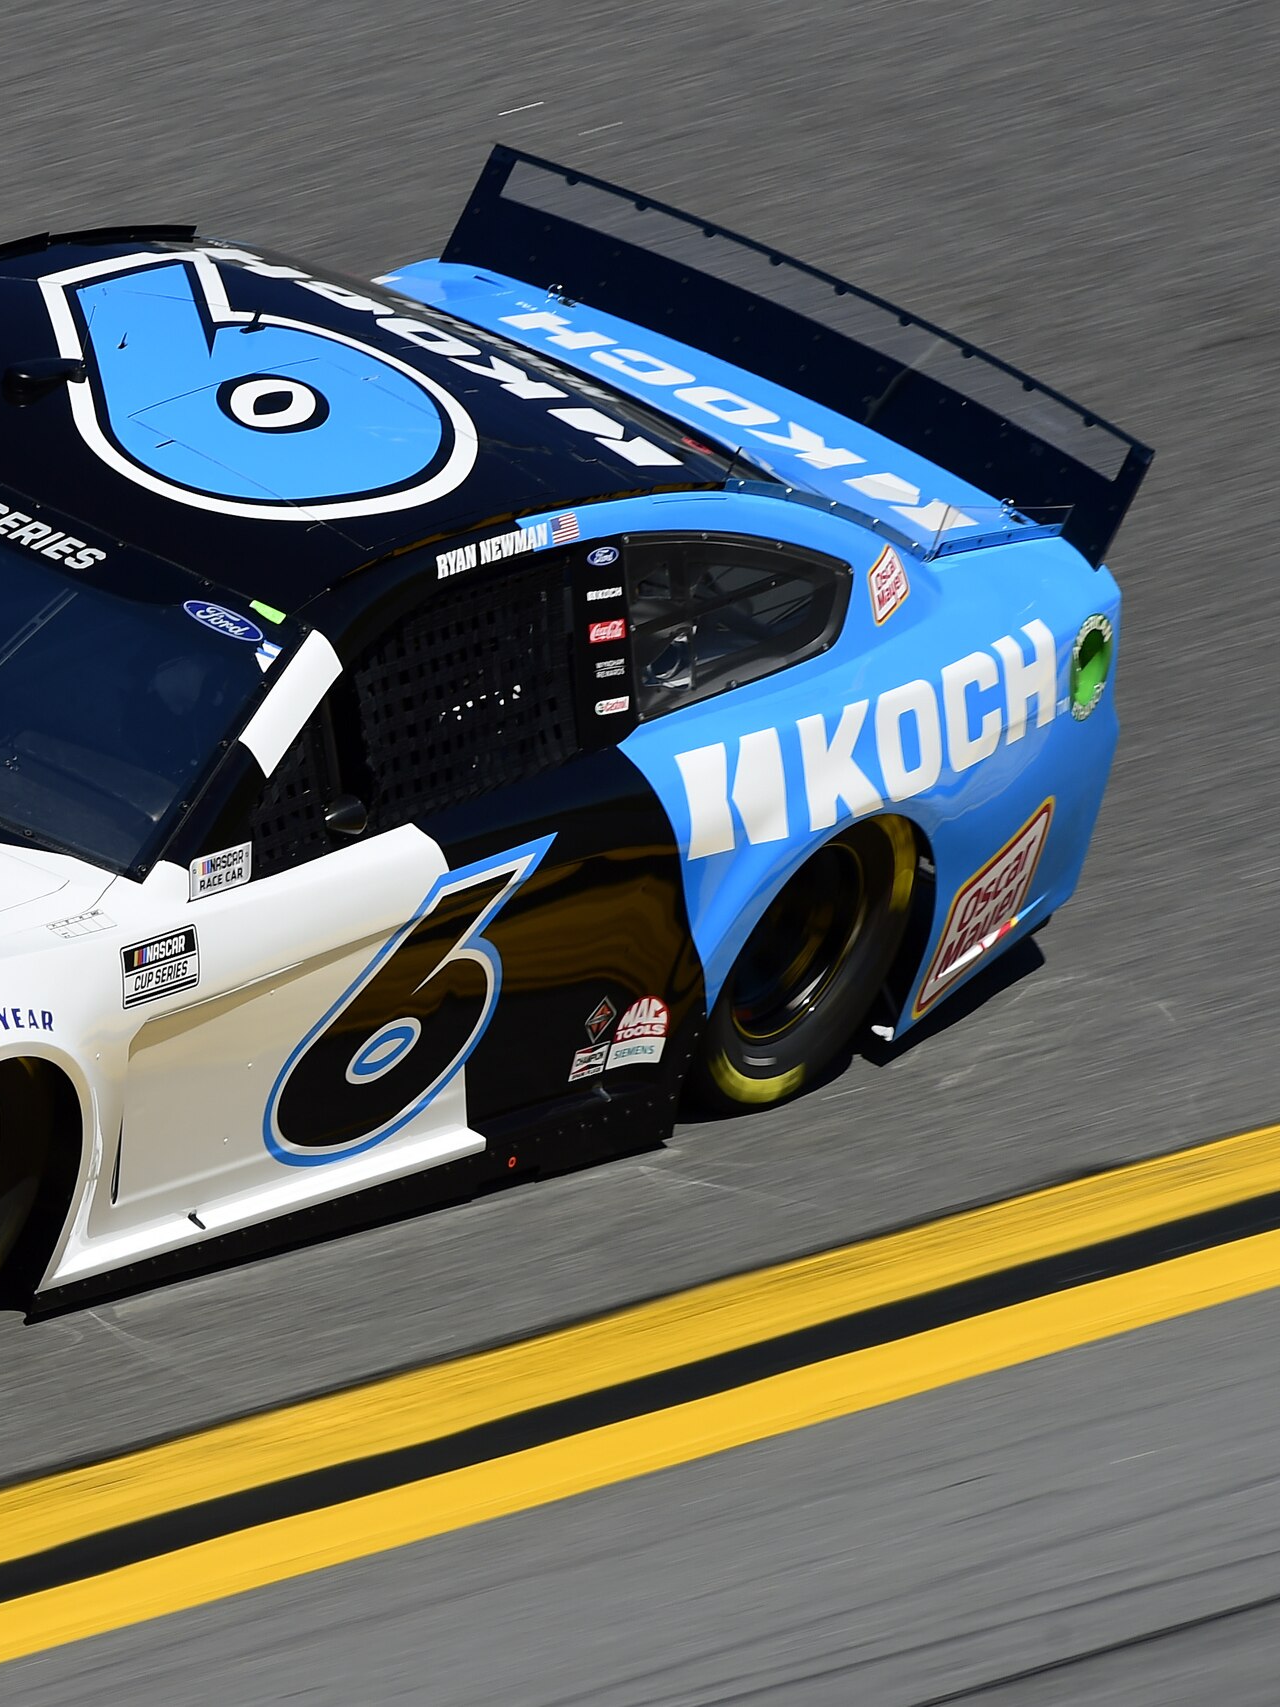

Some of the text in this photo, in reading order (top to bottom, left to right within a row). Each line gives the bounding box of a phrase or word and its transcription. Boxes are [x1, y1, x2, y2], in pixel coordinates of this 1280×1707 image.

[39, 251, 479, 521] 6
[498, 311, 868, 470] KOCH
[436, 522, 548, 580] RYAN NEWMAN
[196, 606, 250, 636] Ford
[795, 618, 1056, 832] KOCH
[210, 849, 244, 872] NASCAR
[199, 867, 244, 891] RACE CAR
[957, 835, 1037, 933] Oscar
[934, 872, 1027, 981] Mayer
[146, 934, 186, 964] NASCAR
[134, 960, 188, 991] CUP SERIES
[262, 832, 558, 1167] 6
[616, 997, 669, 1031] MAC
[616, 1024, 667, 1041] TOOLS
[613, 1045, 656, 1060] SIEMENS
